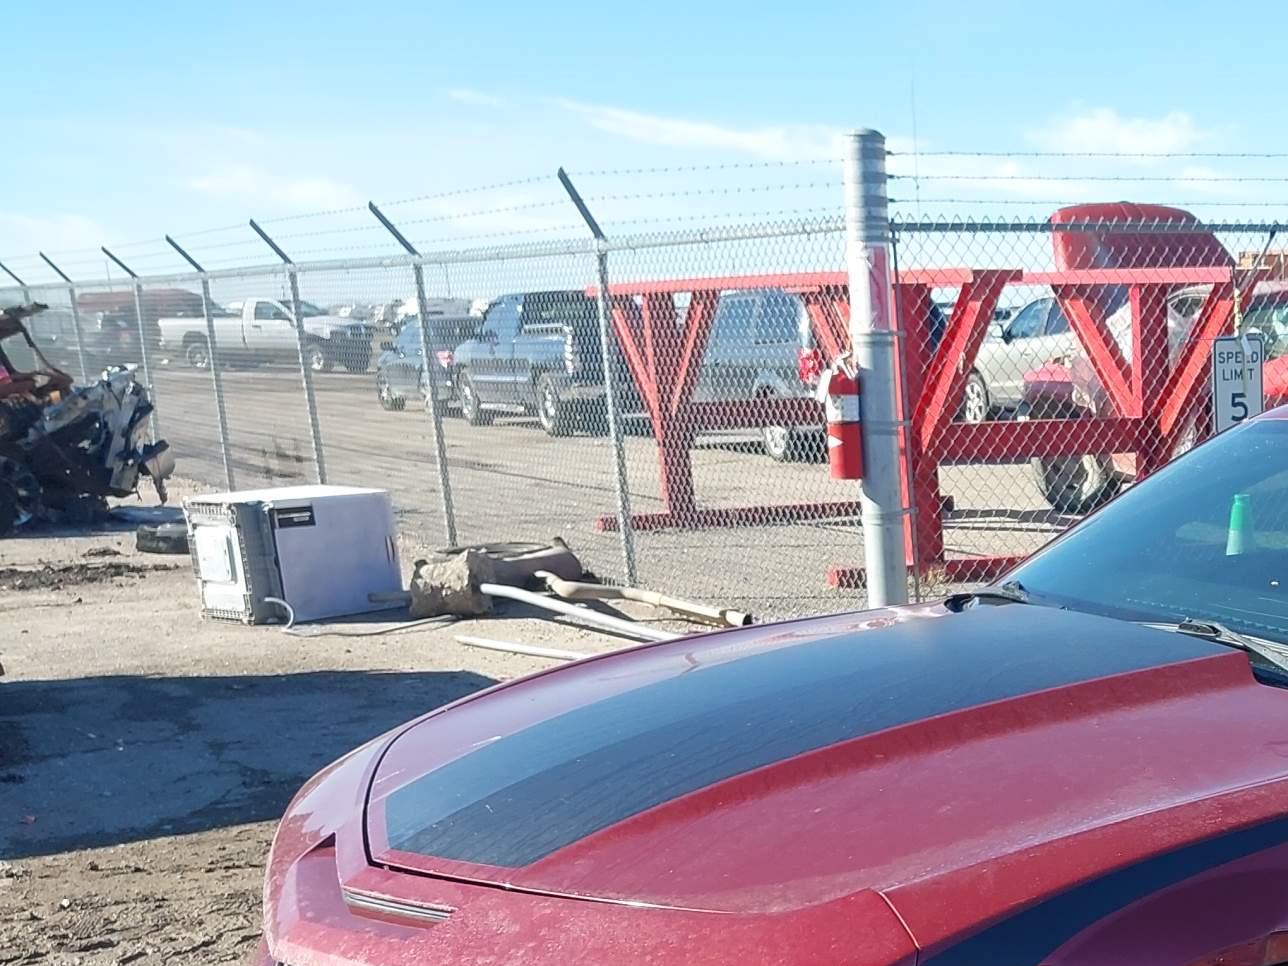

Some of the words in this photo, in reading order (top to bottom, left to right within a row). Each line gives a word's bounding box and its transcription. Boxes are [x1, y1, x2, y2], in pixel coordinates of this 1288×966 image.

[1218, 351, 1259, 364] SPED
[1222, 368, 1255, 381] LIMT
[1231, 392, 1249, 422] 5
